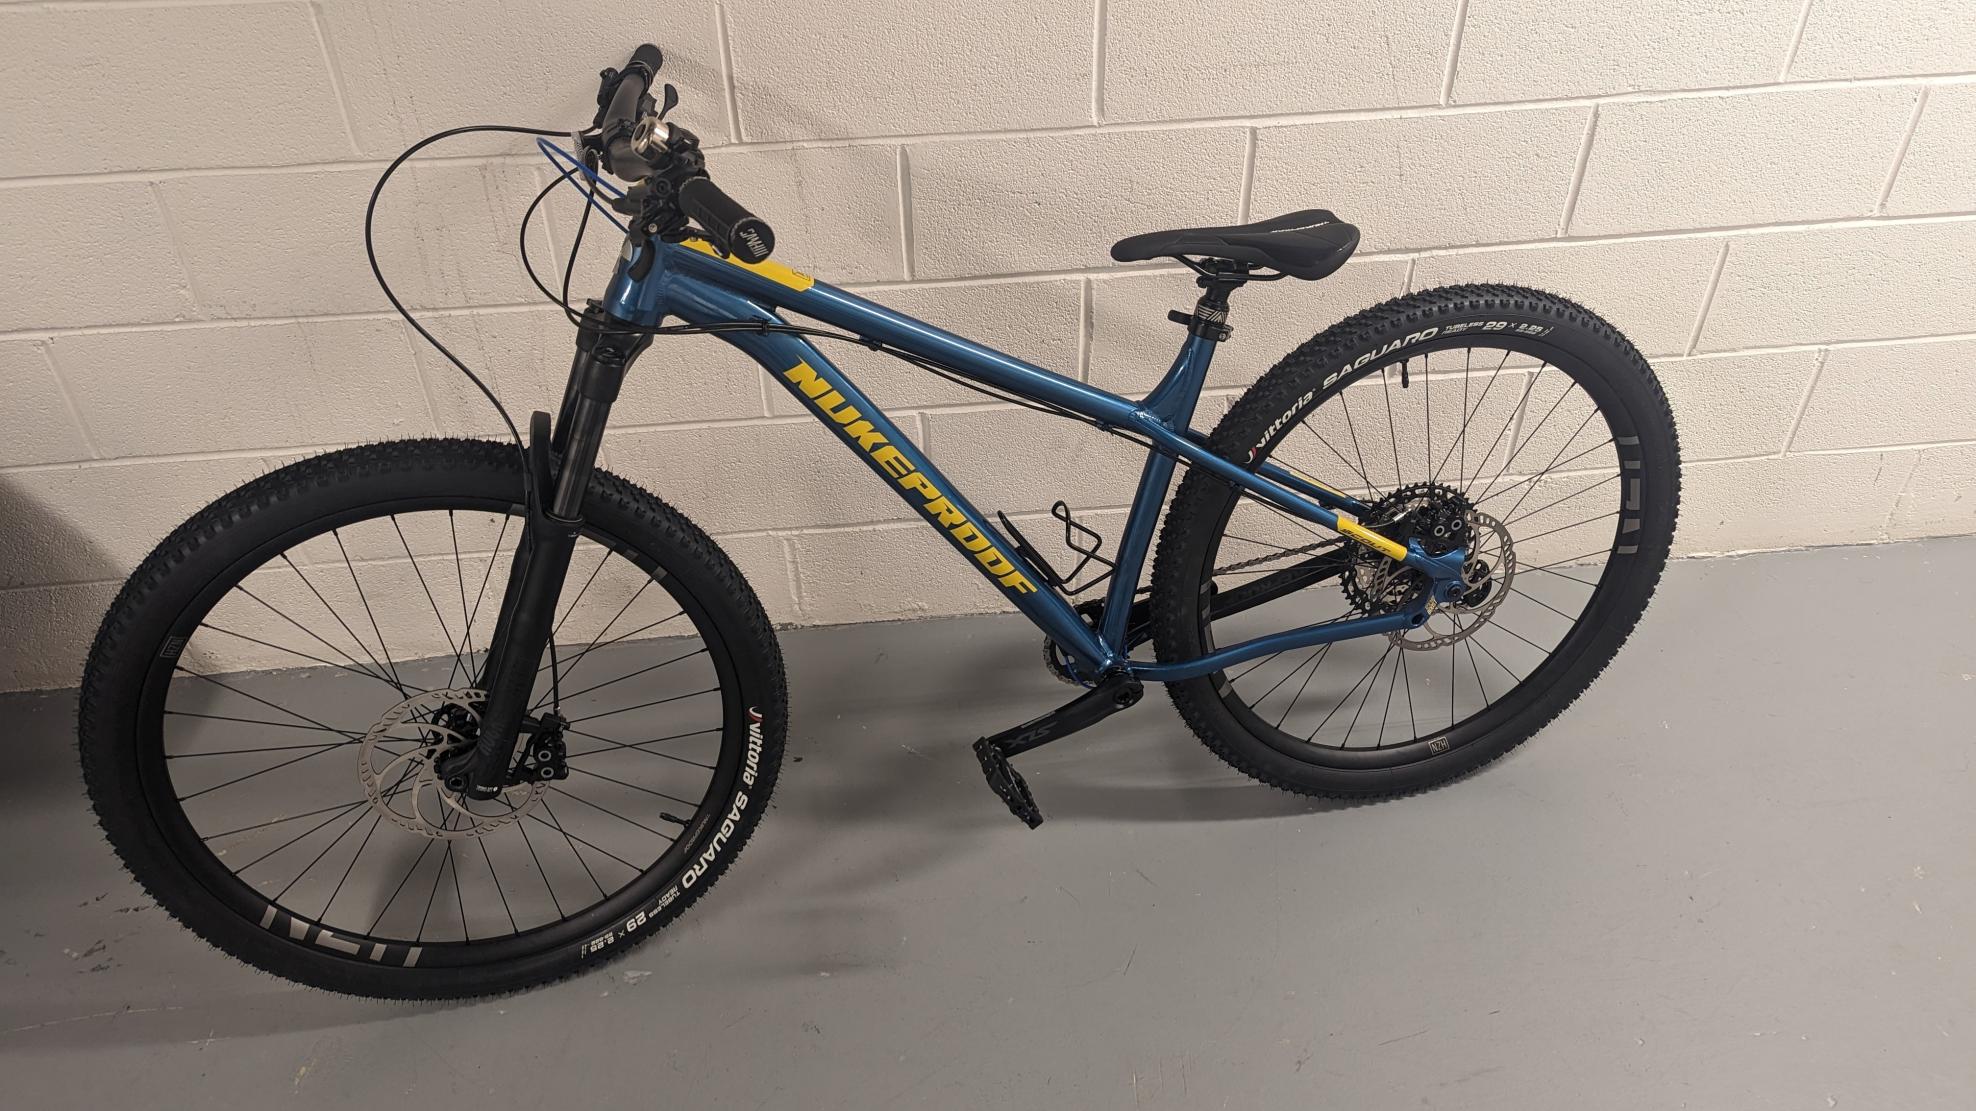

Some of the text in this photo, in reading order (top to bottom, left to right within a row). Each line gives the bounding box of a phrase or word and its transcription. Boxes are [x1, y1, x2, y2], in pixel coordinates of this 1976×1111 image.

[1482, 321, 1508, 331] 29
[1256, 327, 1439, 447] vittoria SAGUARO
[783, 355, 1037, 594] NUKEPROOF
[743, 722, 762, 787] vittoria
[682, 791, 749, 889] SAGUARO
[626, 911, 647, 932] 29
